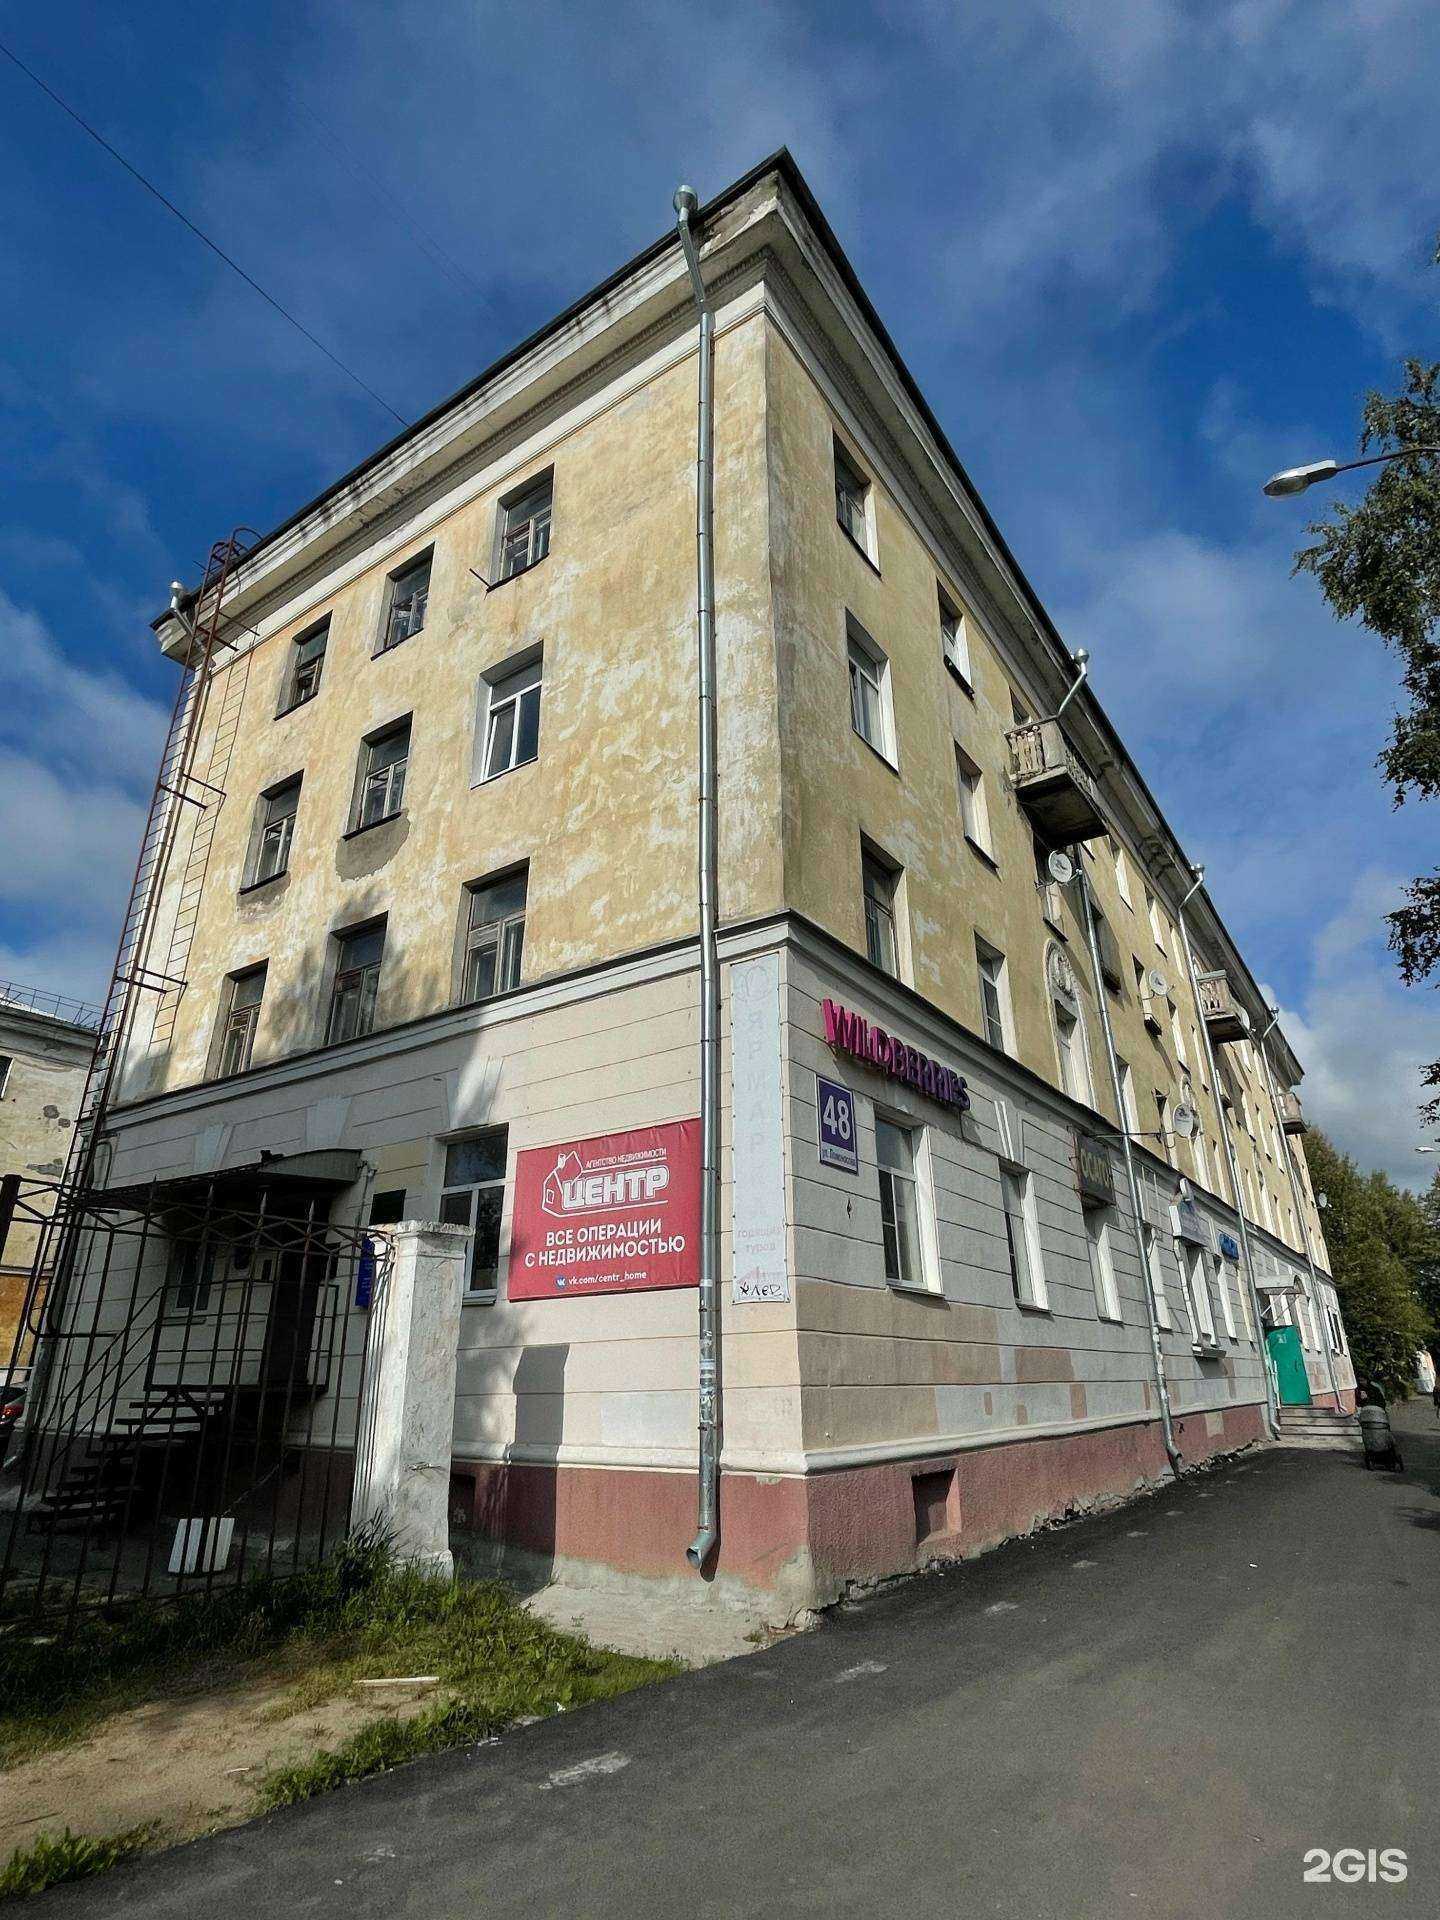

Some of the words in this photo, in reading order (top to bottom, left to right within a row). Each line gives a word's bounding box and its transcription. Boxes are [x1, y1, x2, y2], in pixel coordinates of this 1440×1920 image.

[823, 1095, 851, 1140] 48
[585, 1156, 617, 1169] АГЕНТСТВО
[618, 1147, 667, 1164] НЕДВИЖИМОСТИ
[562, 1166, 669, 1209] ЦЕНТР
[546, 1227, 573, 1247] ВСЕ
[577, 1218, 662, 1242] ОПЕРАЦИИ
[524, 1252, 536, 1267] С
[538, 1235, 686, 1267] НЕДВИЖИМОСТЬЮ
[568, 1270, 647, 1285] vk.com/centr_home
